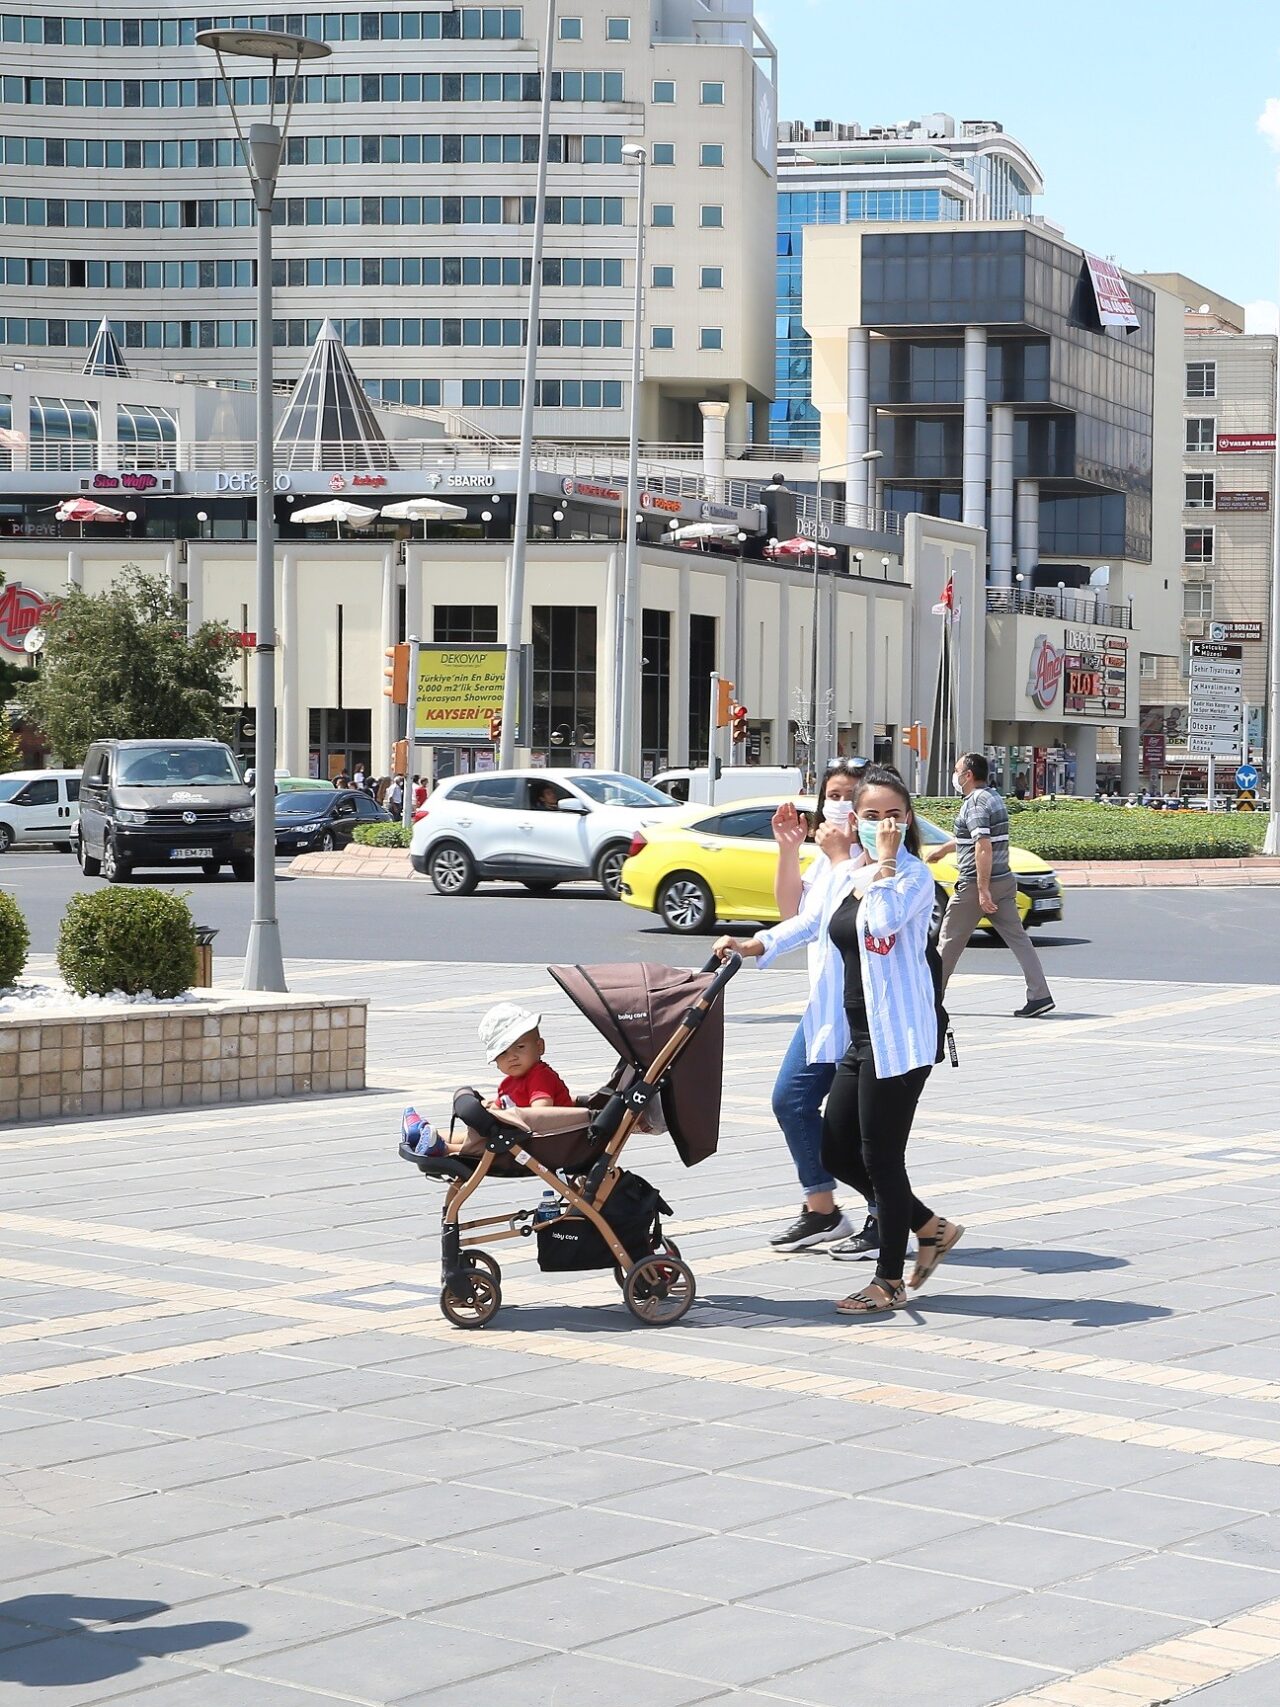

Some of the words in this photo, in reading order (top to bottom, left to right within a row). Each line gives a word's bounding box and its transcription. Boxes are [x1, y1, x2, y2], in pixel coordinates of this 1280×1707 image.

[93, 474, 119, 488] Sisa
[121, 473, 158, 491] Waffle
[215, 471, 292, 492] DeFato
[447, 475, 495, 488] SBARRO
[796, 517, 831, 540] DeFato
[440, 653, 487, 664] DEKOYAP
[1194, 665, 1208, 673] Şehir
[1209, 666, 1235, 675] Tiyatrosu
[420, 673, 468, 684] Türkiye'nin
[471, 673, 481, 681] En
[484, 673, 505, 682] Büyü
[1069, 672, 1092, 696] FLO
[474, 683, 505, 692] Serami
[416, 694, 462, 703] ekorasyon
[463, 692, 504, 702] Showroo
[1192, 721, 1217, 731] Otogar
